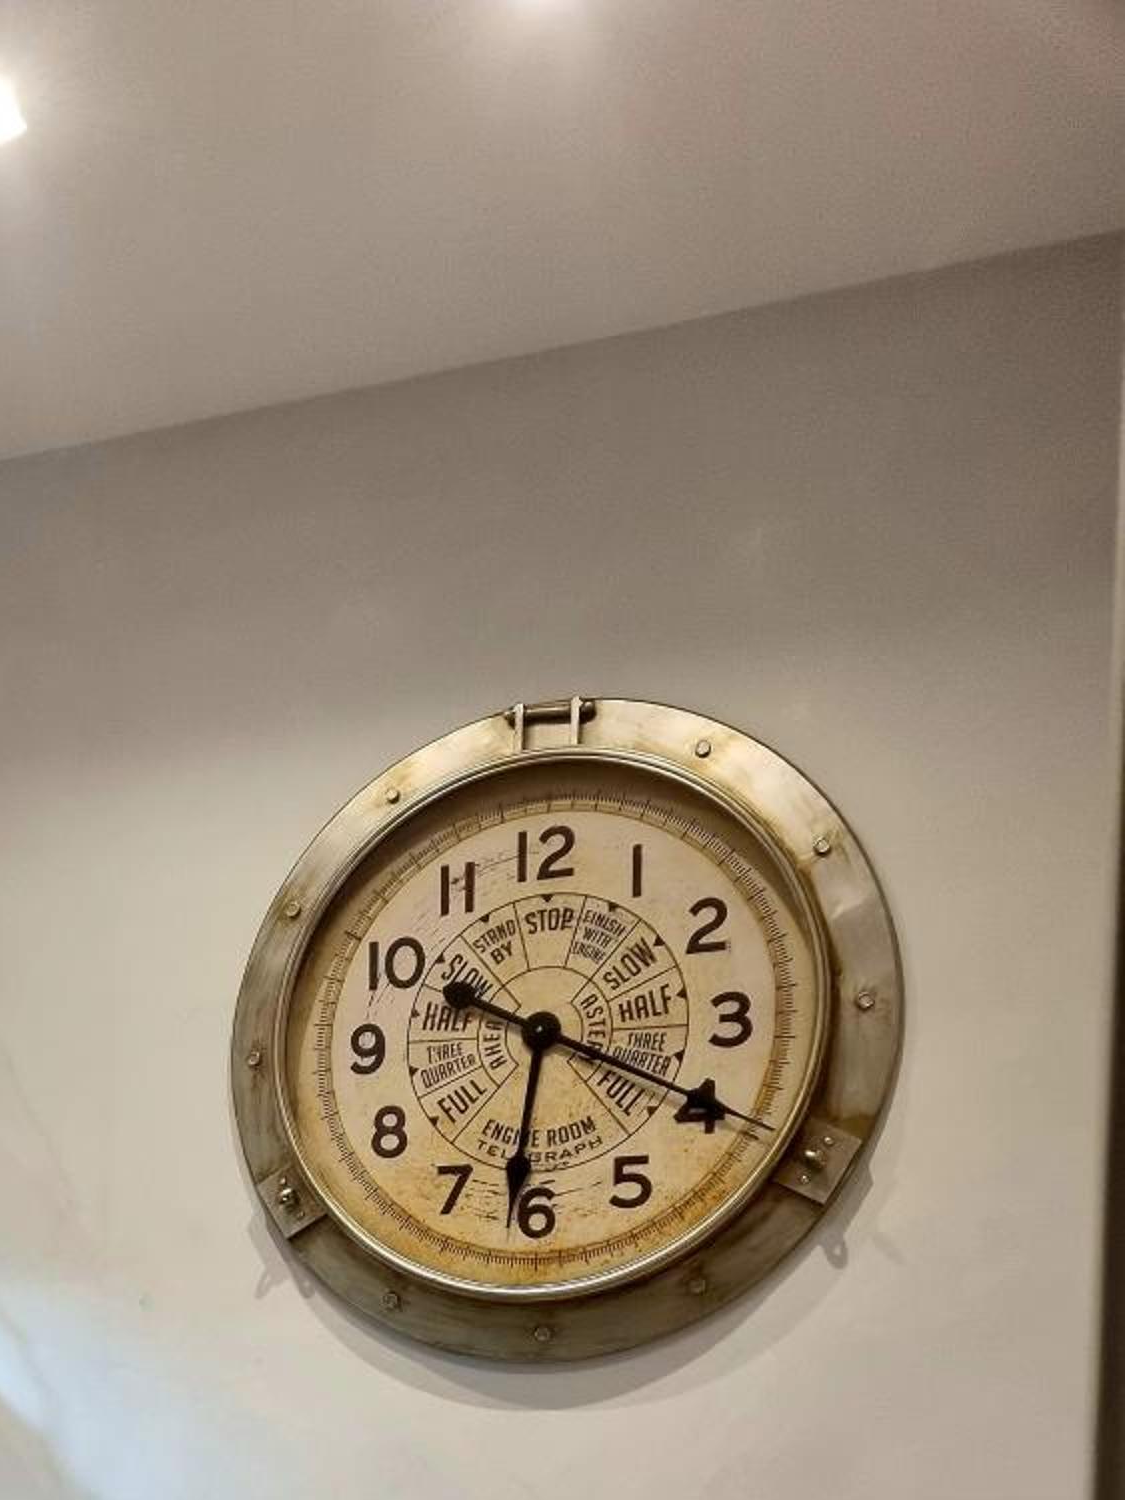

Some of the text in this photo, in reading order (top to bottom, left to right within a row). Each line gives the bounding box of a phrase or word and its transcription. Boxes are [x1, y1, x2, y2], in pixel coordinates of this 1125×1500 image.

[518, 825, 575, 883] 12
[632, 844, 642, 898] 1
[440, 862, 476, 917] 11
[472, 919, 516, 953] STAND
[525, 907, 575, 934] STOP
[583, 908, 626, 937] FINISH
[686, 897, 728, 955] 2
[368, 935, 426, 991] 10
[490, 941, 512, 965] BY
[603, 937, 657, 990] SLOW
[422, 1001, 475, 1032] HALF
[618, 983, 672, 1022] HALF
[708, 991, 753, 1048] 3
[350, 1023, 386, 1075] 9
[483, 1014, 508, 1071] AHEA
[628, 1031, 668, 1052] THREE
[420, 1053, 476, 1089] QUARTER
[596, 1069, 646, 1116] FULL
[437, 1079, 487, 1124] FULL
[371, 1105, 408, 1159] 8
[477, 1135, 603, 1163] TELGRAPH
[546, 1115, 596, 1148] ROOM
[437, 1163, 474, 1215] 7
[609, 1155, 653, 1209] 5
[518, 1186, 556, 1239] 6
